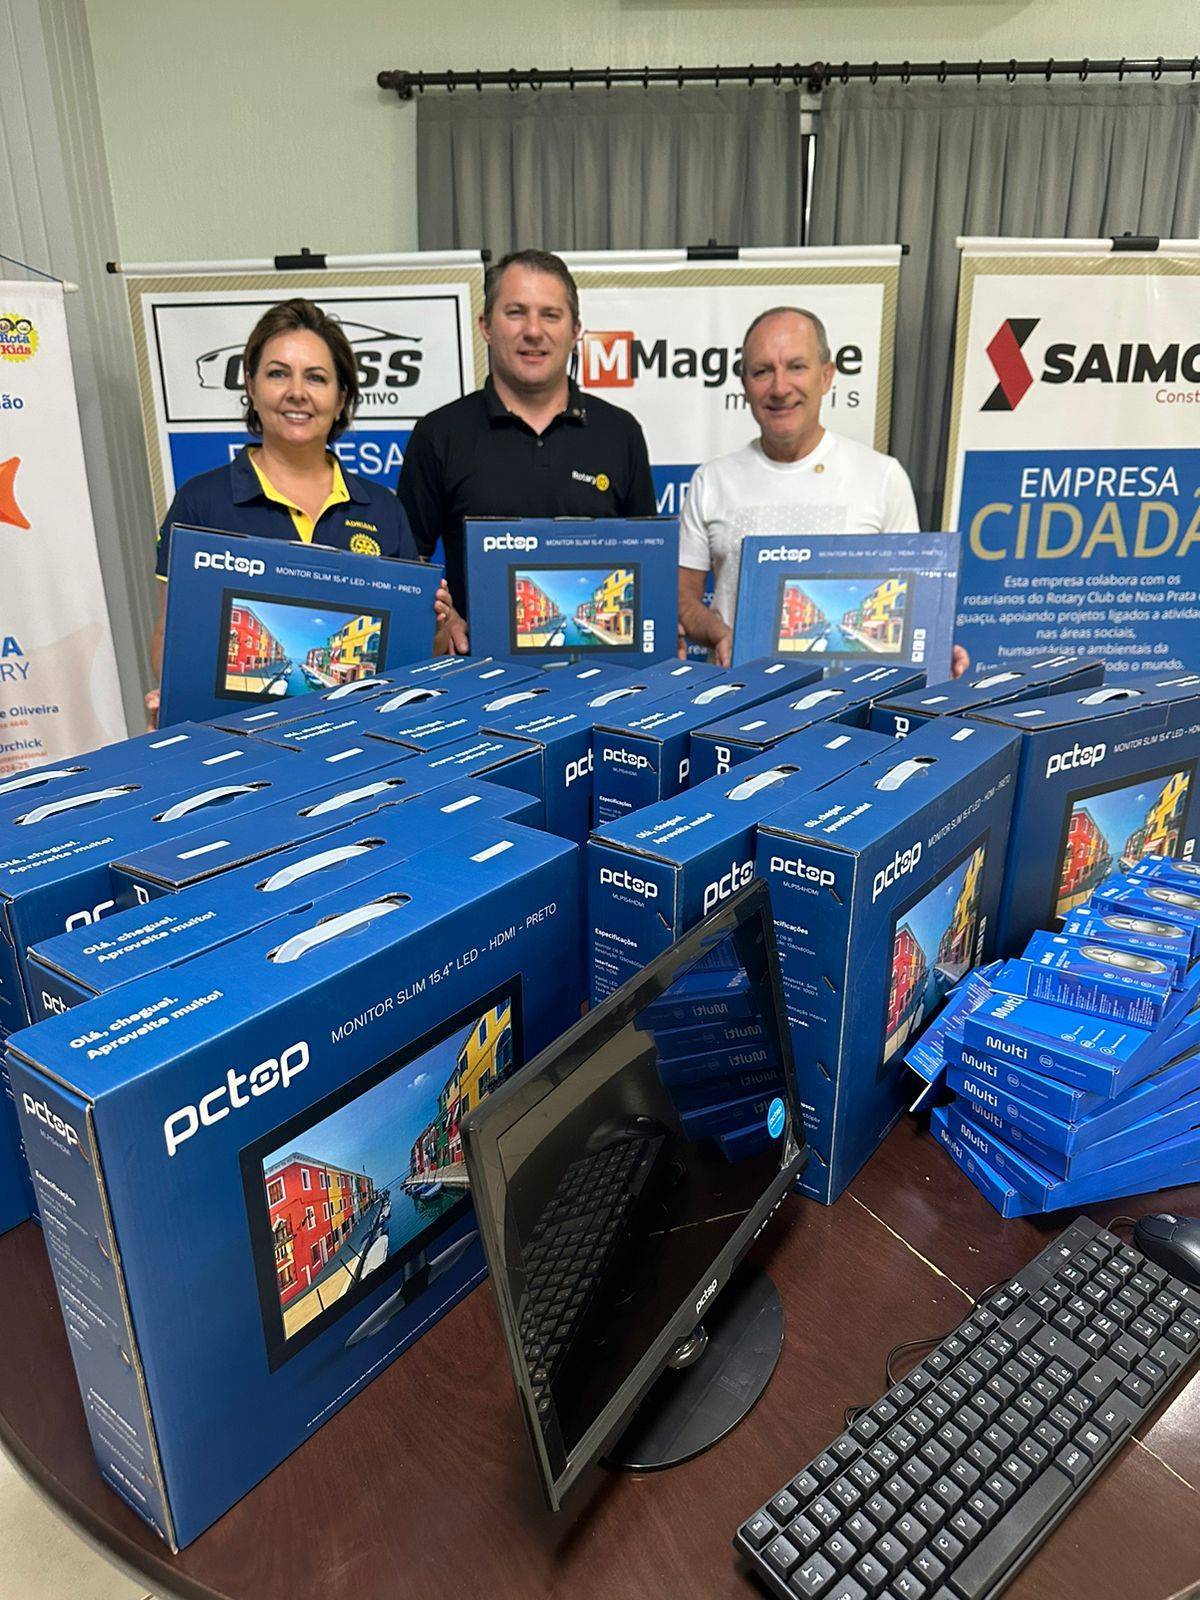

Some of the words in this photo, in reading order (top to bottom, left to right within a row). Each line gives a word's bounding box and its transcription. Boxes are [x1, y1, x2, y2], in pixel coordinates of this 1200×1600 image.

[0, 333, 30, 343] Rota
[1, 345, 32, 354] Kids
[2, 394, 24, 409] ão
[572, 470, 597, 485] Rotary
[1020, 466, 1179, 498] EMPRESA
[484, 532, 538, 552] pctop
[758, 546, 811, 563] pctop
[194, 551, 265, 577] pctop
[276, 567, 312, 578] MONITOR
[313, 572, 331, 581] SLIM
[333, 575, 349, 583] 15.4"
[350, 578, 365, 586] LED
[372, 581, 391, 590] HDMI
[398, 584, 422, 594] PRETO
[1004, 575, 1029, 588] Esta
[1031, 576, 1083, 590] empresa
[1086, 573, 1138, 586] colabora
[1140, 574, 1165, 586] com
[1166, 574, 1181, 585] os
[963, 594, 1025, 606] rotarianos
[1027, 592, 1044, 605] do
[1046, 591, 1085, 606] Rotary
[1087, 591, 1115, 604] Club
[1117, 591, 1134, 603] de
[1135, 590, 1164, 603] Nova
[1166, 590, 1197, 602] Prata
[956, 613, 997, 627] guaçu,
[999, 610, 1055, 626] apoiando
[1057, 608, 1106, 624] projetos
[1108, 608, 1150, 623] ligados
[1152, 610, 1160, 620] a
[1036, 629, 1057, 640] nas
[1060, 627, 1092, 640] áreas
[1094, 626, 1137, 640] sociais,
[998, 644, 1075, 657] humanitárias
[1077, 646, 1085, 655] e
[1087, 643, 1152, 655] ambientais
[1153, 642, 1169, 654] da
[1104, 660, 1130, 672] odo
[1131, 662, 1140, 671] o
[1141, 659, 1185, 671] mundo.
[10, 704, 59, 717] Oliveira
[603, 748, 648, 769] pctop
[1046, 743, 1106, 779] pctop
[770, 856, 835, 886] pctop
[872, 841, 922, 904] pctop
[599, 868, 658, 899] pctop
[82, 940, 117, 955] Olá,
[117, 916, 178, 942] cheguei.
[98, 930, 171, 963] Aproveite
[170, 910, 217, 934] muito!
[594, 927, 638, 948] Especificações
[990, 994, 1024, 1019] Multi
[69, 1028, 109, 1049] Olá,
[109, 997, 180, 1031] cheguei.
[86, 1016, 170, 1061] Aproveite
[170, 988, 225, 1020] muito!
[163, 1041, 310, 1158] pctop
[331, 997, 394, 1044] MONITOR
[396, 977, 426, 1005] SLIM
[428, 960, 454, 986] 15.4"
[456, 948, 479, 970] LED
[489, 926, 516, 951] HDMI
[526, 902, 558, 930] PRETO
[986, 1036, 1028, 1060] Multi
[961, 1051, 998, 1079] Multi
[964, 1080, 998, 1108] Multi
[23, 1092, 79, 1146] pctop
[971, 1101, 1003, 1129] Multi
[941, 1129, 963, 1160] Multi
[960, 1123, 989, 1155] Multi
[696, 1279, 718, 1314] pctop
[992, 1380, 1000, 1389] P
[977, 1397, 986, 1405] O
[1005, 1415, 1014, 1423] L
[943, 1429, 953, 1438] U
[989, 1430, 999, 1440] K
[925, 1446, 935, 1455] Y
[974, 1448, 981, 1457] J
[907, 1464, 918, 1473] T
[956, 1465, 966, 1474] H
[890, 1482, 901, 1491] R
[939, 1483, 949, 1493] G
[991, 1480, 1002, 1489] N
[871, 1502, 881, 1511] E
[920, 1502, 929, 1511] F
[974, 1499, 984, 1509] B
[851, 1519, 862, 1529] W
[901, 1521, 911, 1530] D
[957, 1518, 967, 1527] V
[831, 1541, 842, 1551] Q
[882, 1541, 891, 1551] S
[939, 1538, 949, 1548] C
[861, 1562, 872, 1573] A
[919, 1558, 930, 1569] X
[900, 1579, 910, 1591] Z
